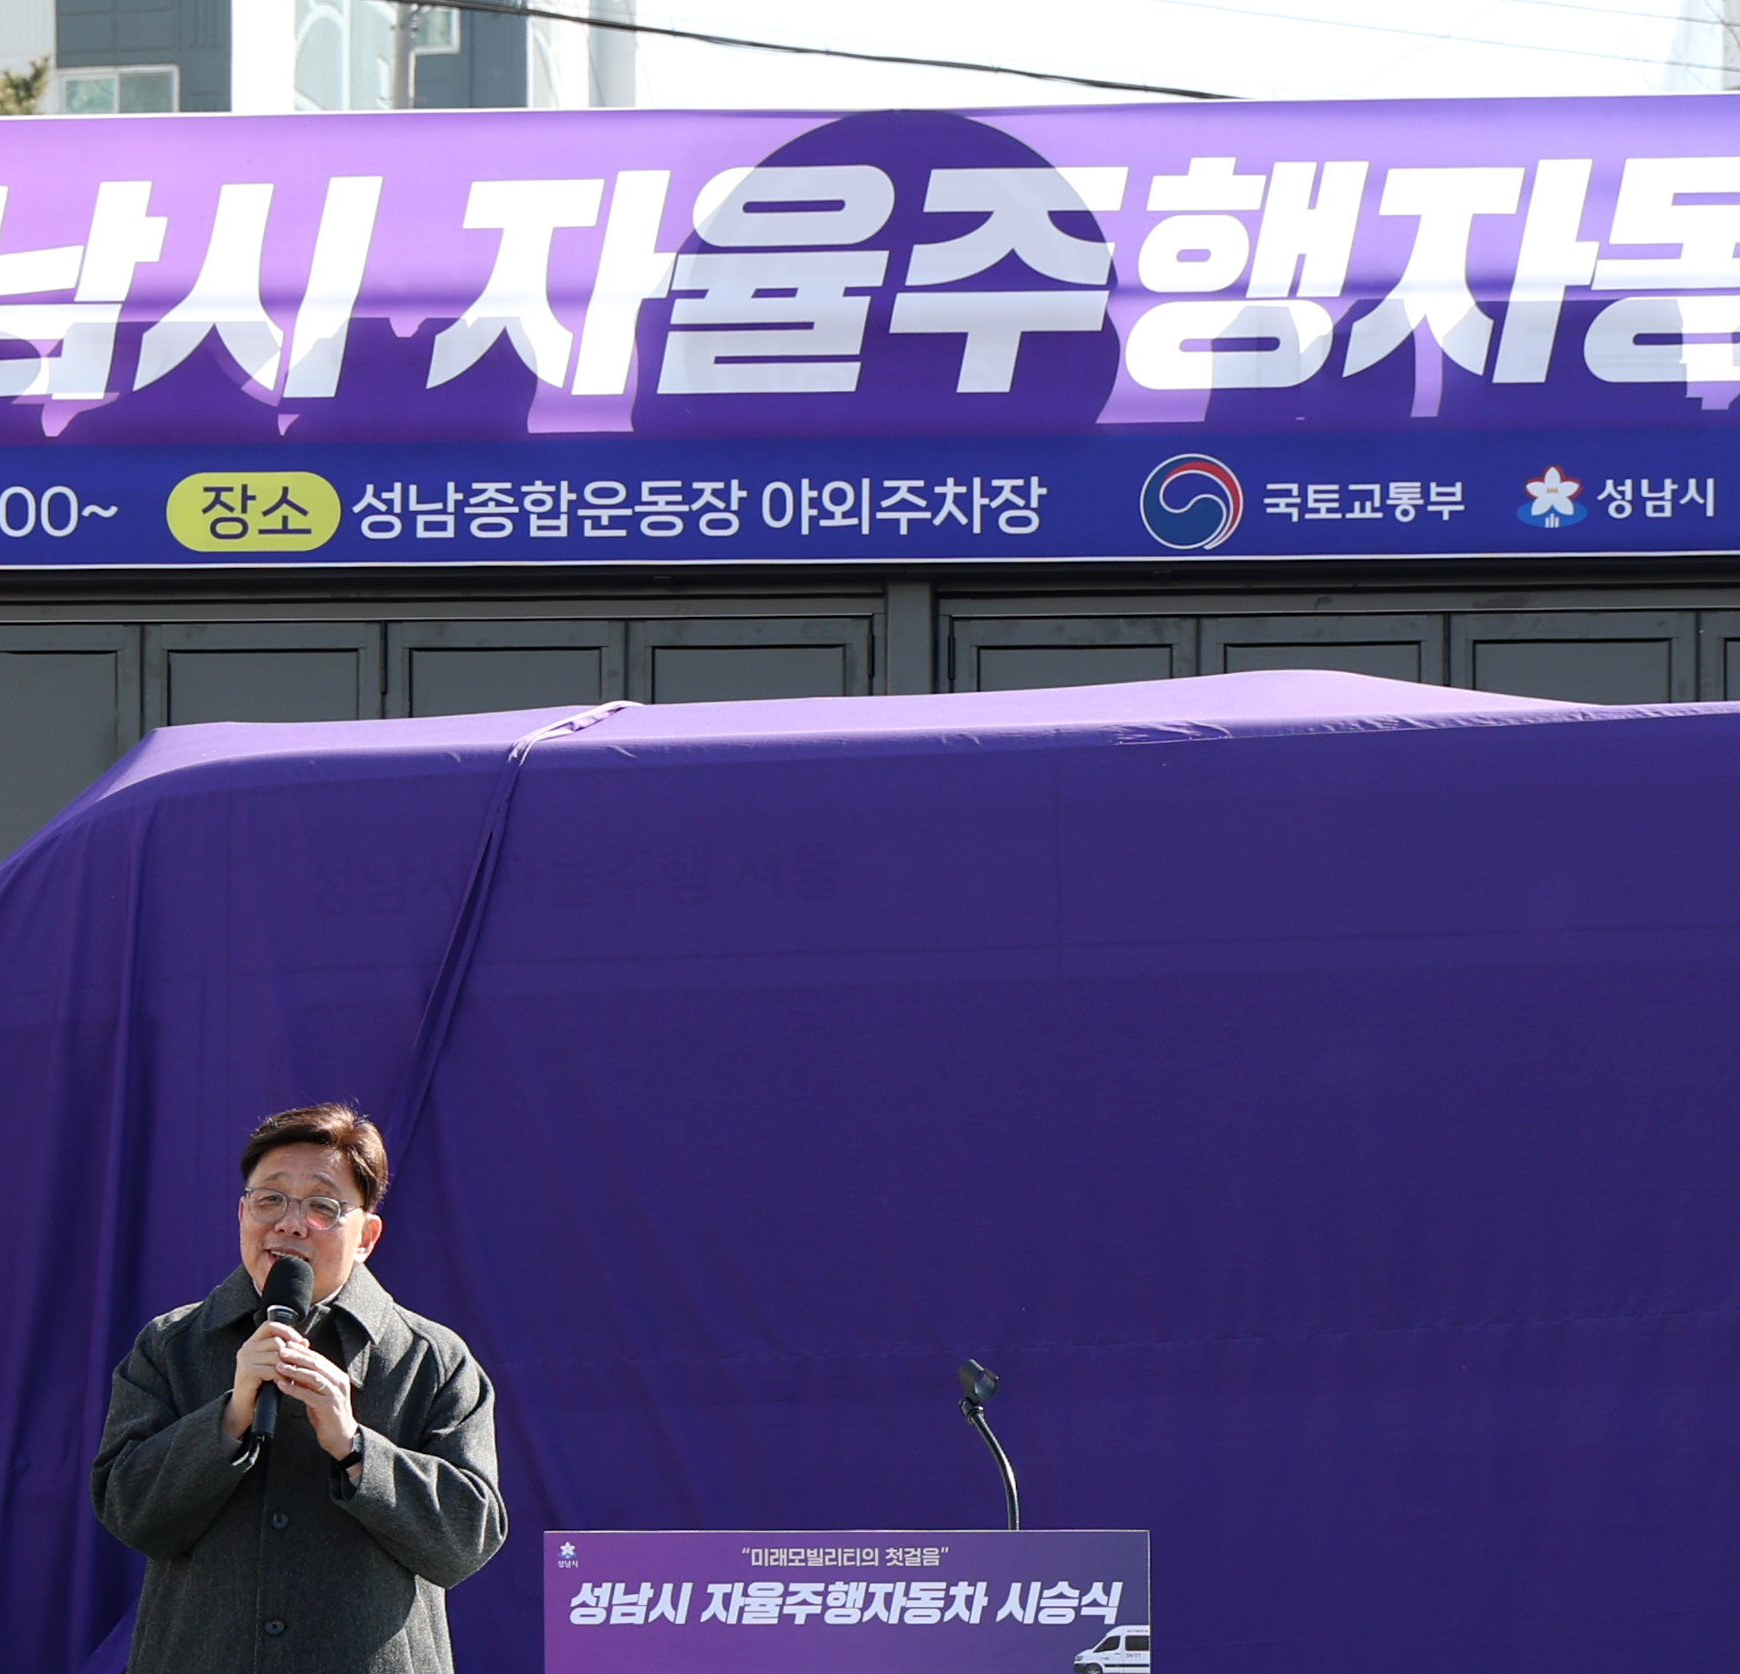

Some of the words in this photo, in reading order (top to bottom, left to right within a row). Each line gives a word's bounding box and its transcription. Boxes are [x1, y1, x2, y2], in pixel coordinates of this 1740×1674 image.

[201, 485, 311, 540] 장소
[353, 479, 747, 541] 성남종합운동장
[762, 476, 1048, 536] 야외주차장
[1264, 481, 1465, 525] 국토교통부
[1597, 478, 1716, 519] 성남시
[569, 1582, 692, 1625] 성남시
[699, 1582, 989, 1625] 자율주행자동차
[995, 1581, 1123, 1625] 시승식
